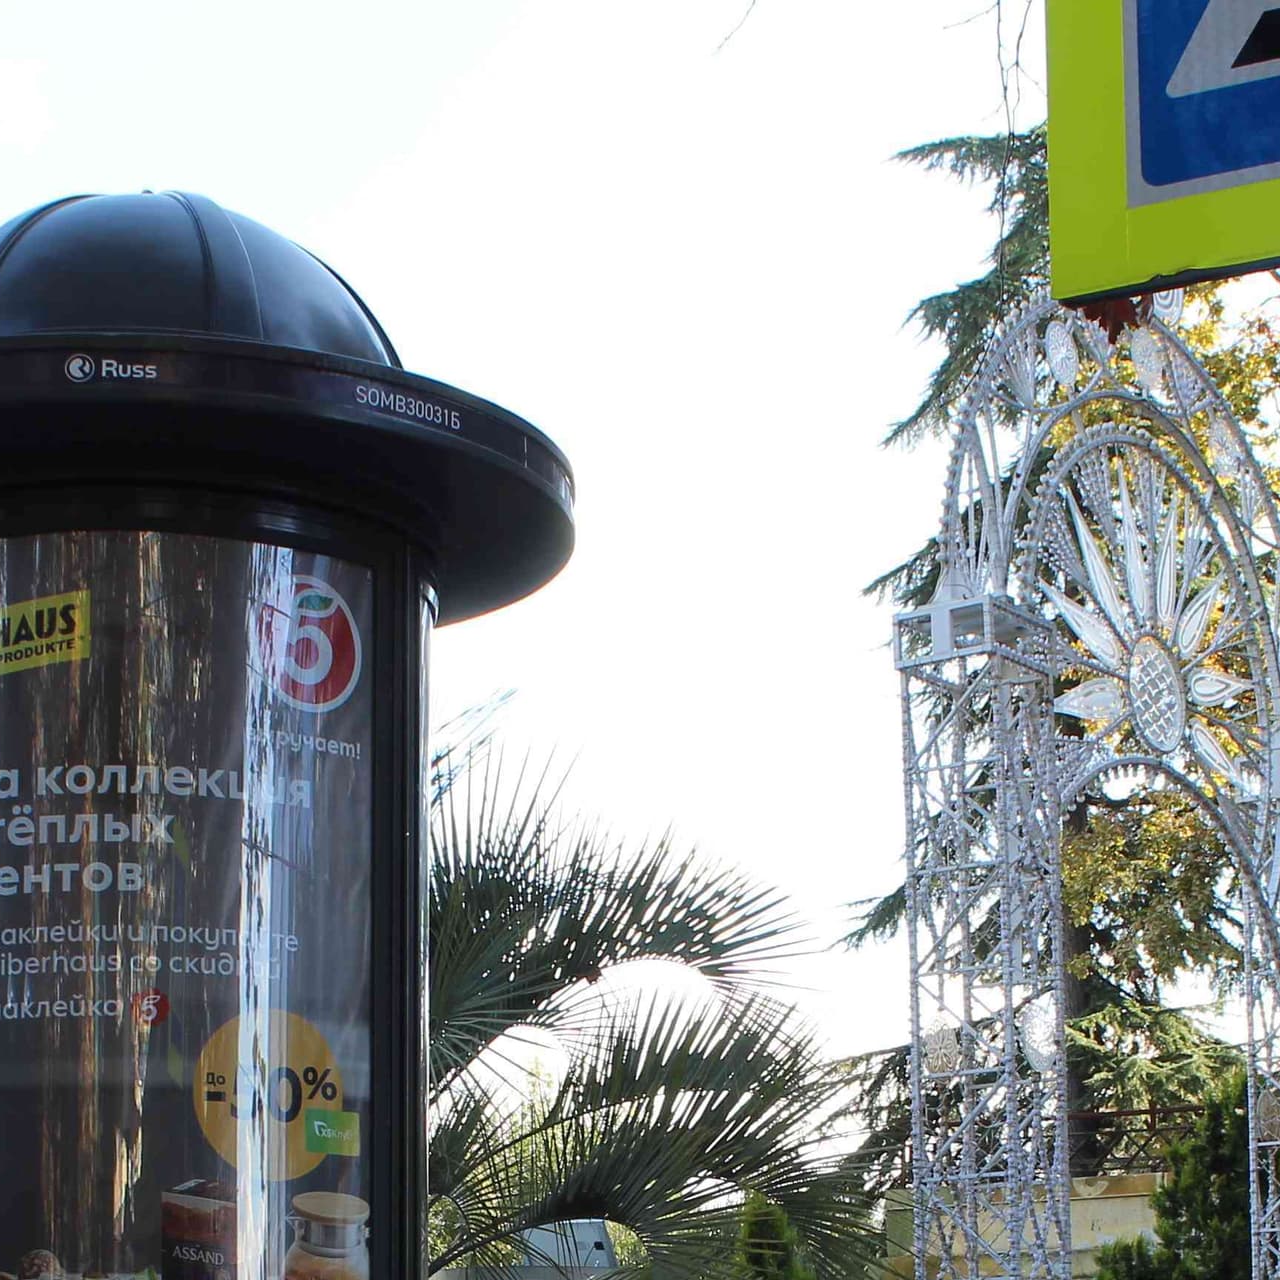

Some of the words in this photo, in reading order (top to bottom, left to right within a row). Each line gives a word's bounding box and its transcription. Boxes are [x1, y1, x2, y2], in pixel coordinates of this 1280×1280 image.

[101, 359, 159, 379] Russ
[249, 727, 361, 760] вручает!
[153, 925, 300, 952] покупте
[132, 956, 162, 973] со
[169, 952, 282, 982] скидой
[206, 1071, 227, 1087] До
